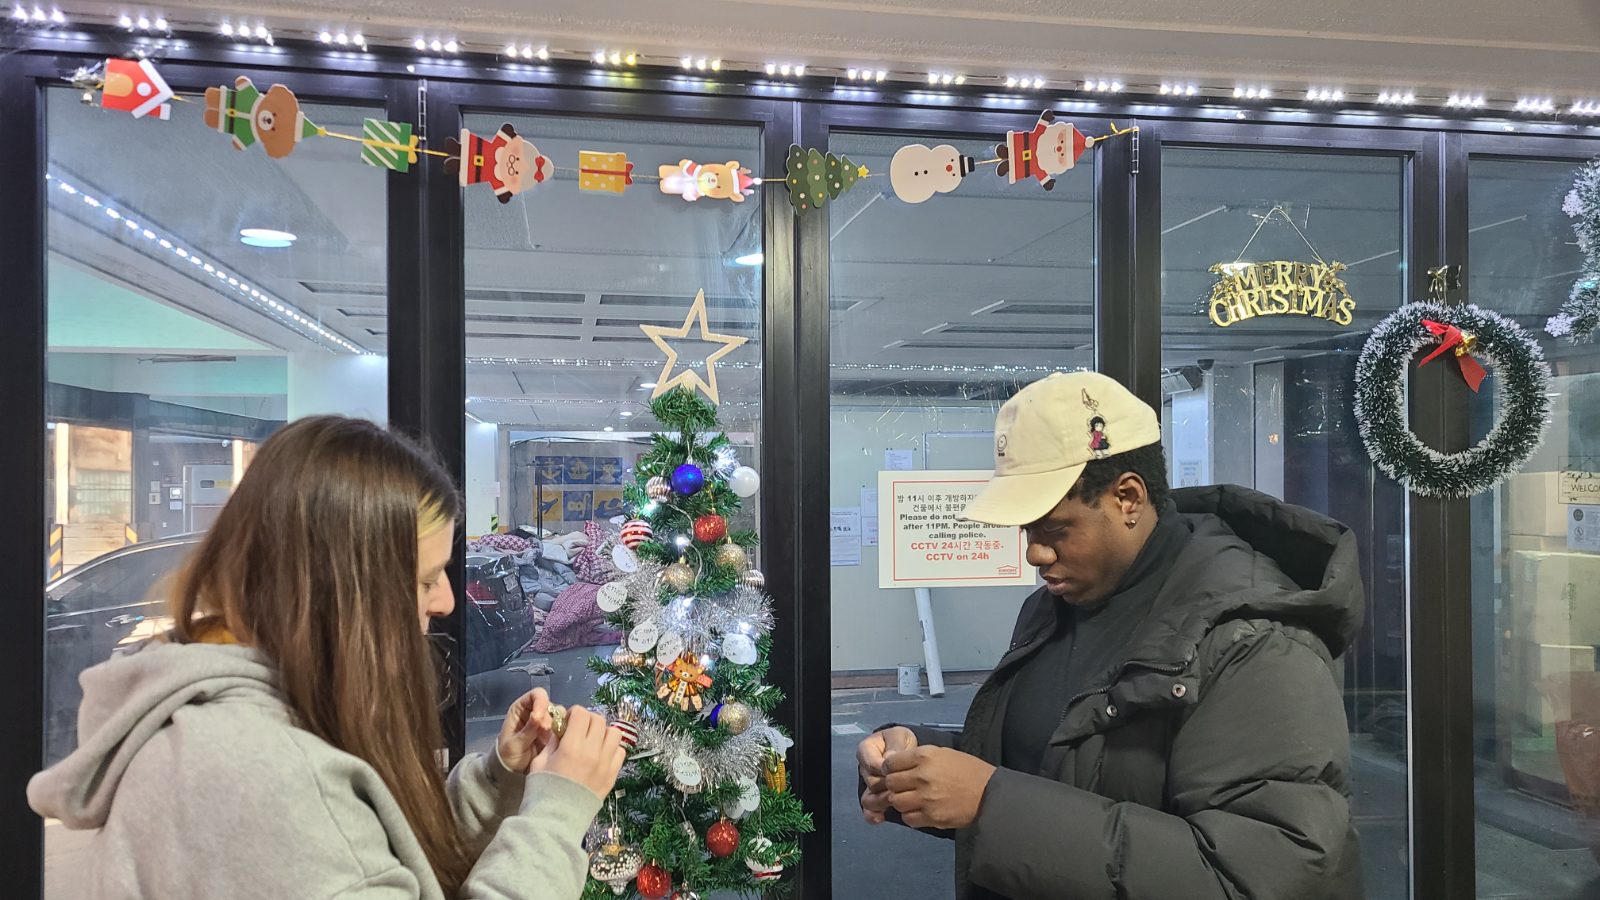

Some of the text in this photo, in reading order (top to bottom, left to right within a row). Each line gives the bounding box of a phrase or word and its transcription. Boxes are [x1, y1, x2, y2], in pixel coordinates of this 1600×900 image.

[1233, 260, 1328, 291] MERRY
[1209, 286, 1356, 327] CHRISTMAS
[1571, 483, 1600, 493] WELCO
[907, 495, 925, 503] 11시
[927, 494, 943, 503] 이후
[945, 494, 978, 503] 개방하지
[912, 503, 942, 513] 건물에서
[899, 513, 928, 521] Please
[929, 513, 940, 521] do
[953, 522, 981, 531] People
[929, 531, 986, 540] calling police.
[911, 542, 939, 550] CCTV
[941, 541, 971, 551] 24시간
[926, 552, 989, 561] CCTV on 24h
